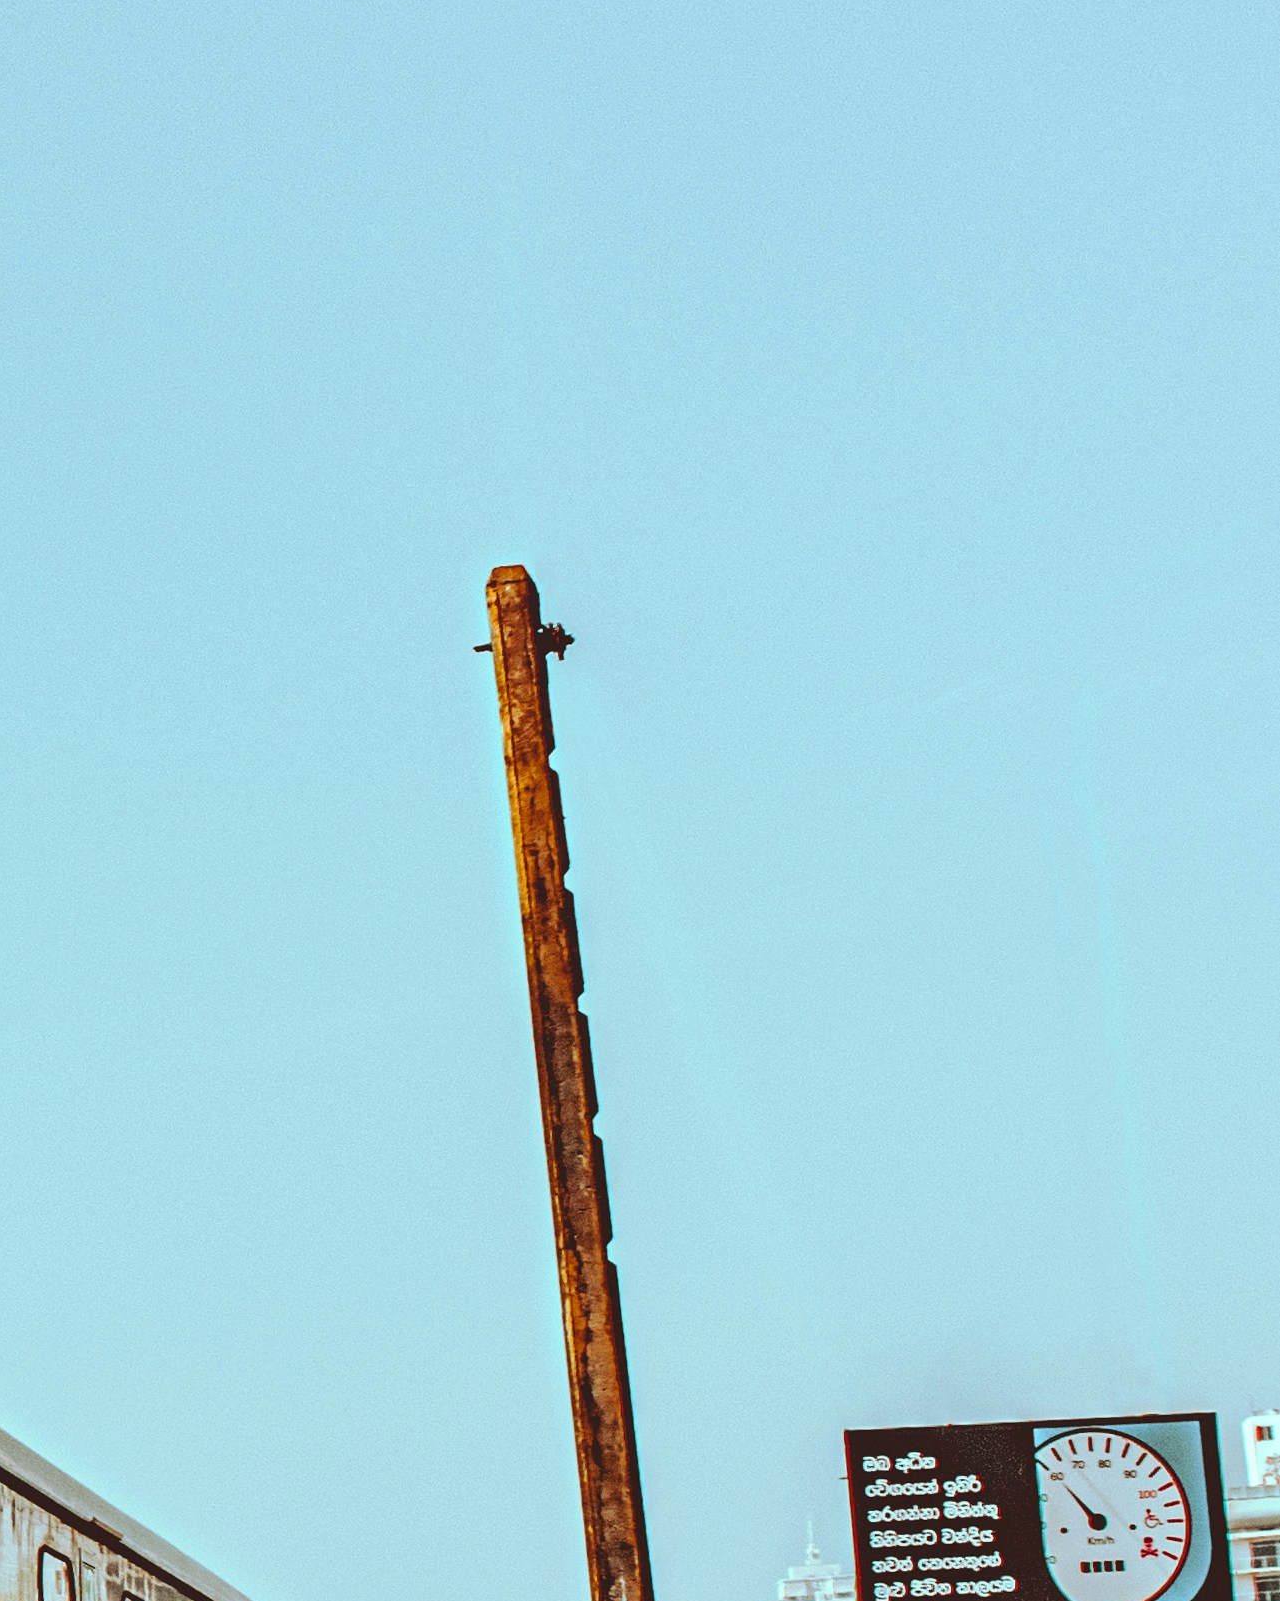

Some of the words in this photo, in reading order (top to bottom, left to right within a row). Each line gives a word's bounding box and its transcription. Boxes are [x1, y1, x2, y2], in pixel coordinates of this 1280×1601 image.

[862, 1455, 891, 1472] ඔබ
[1072, 1460, 1085, 1469] 70
[1098, 1459, 1111, 1468] 80
[1050, 1472, 1064, 1481] 60
[1124, 1470, 1137, 1479] 90
[1138, 1489, 1157, 1499] 100
